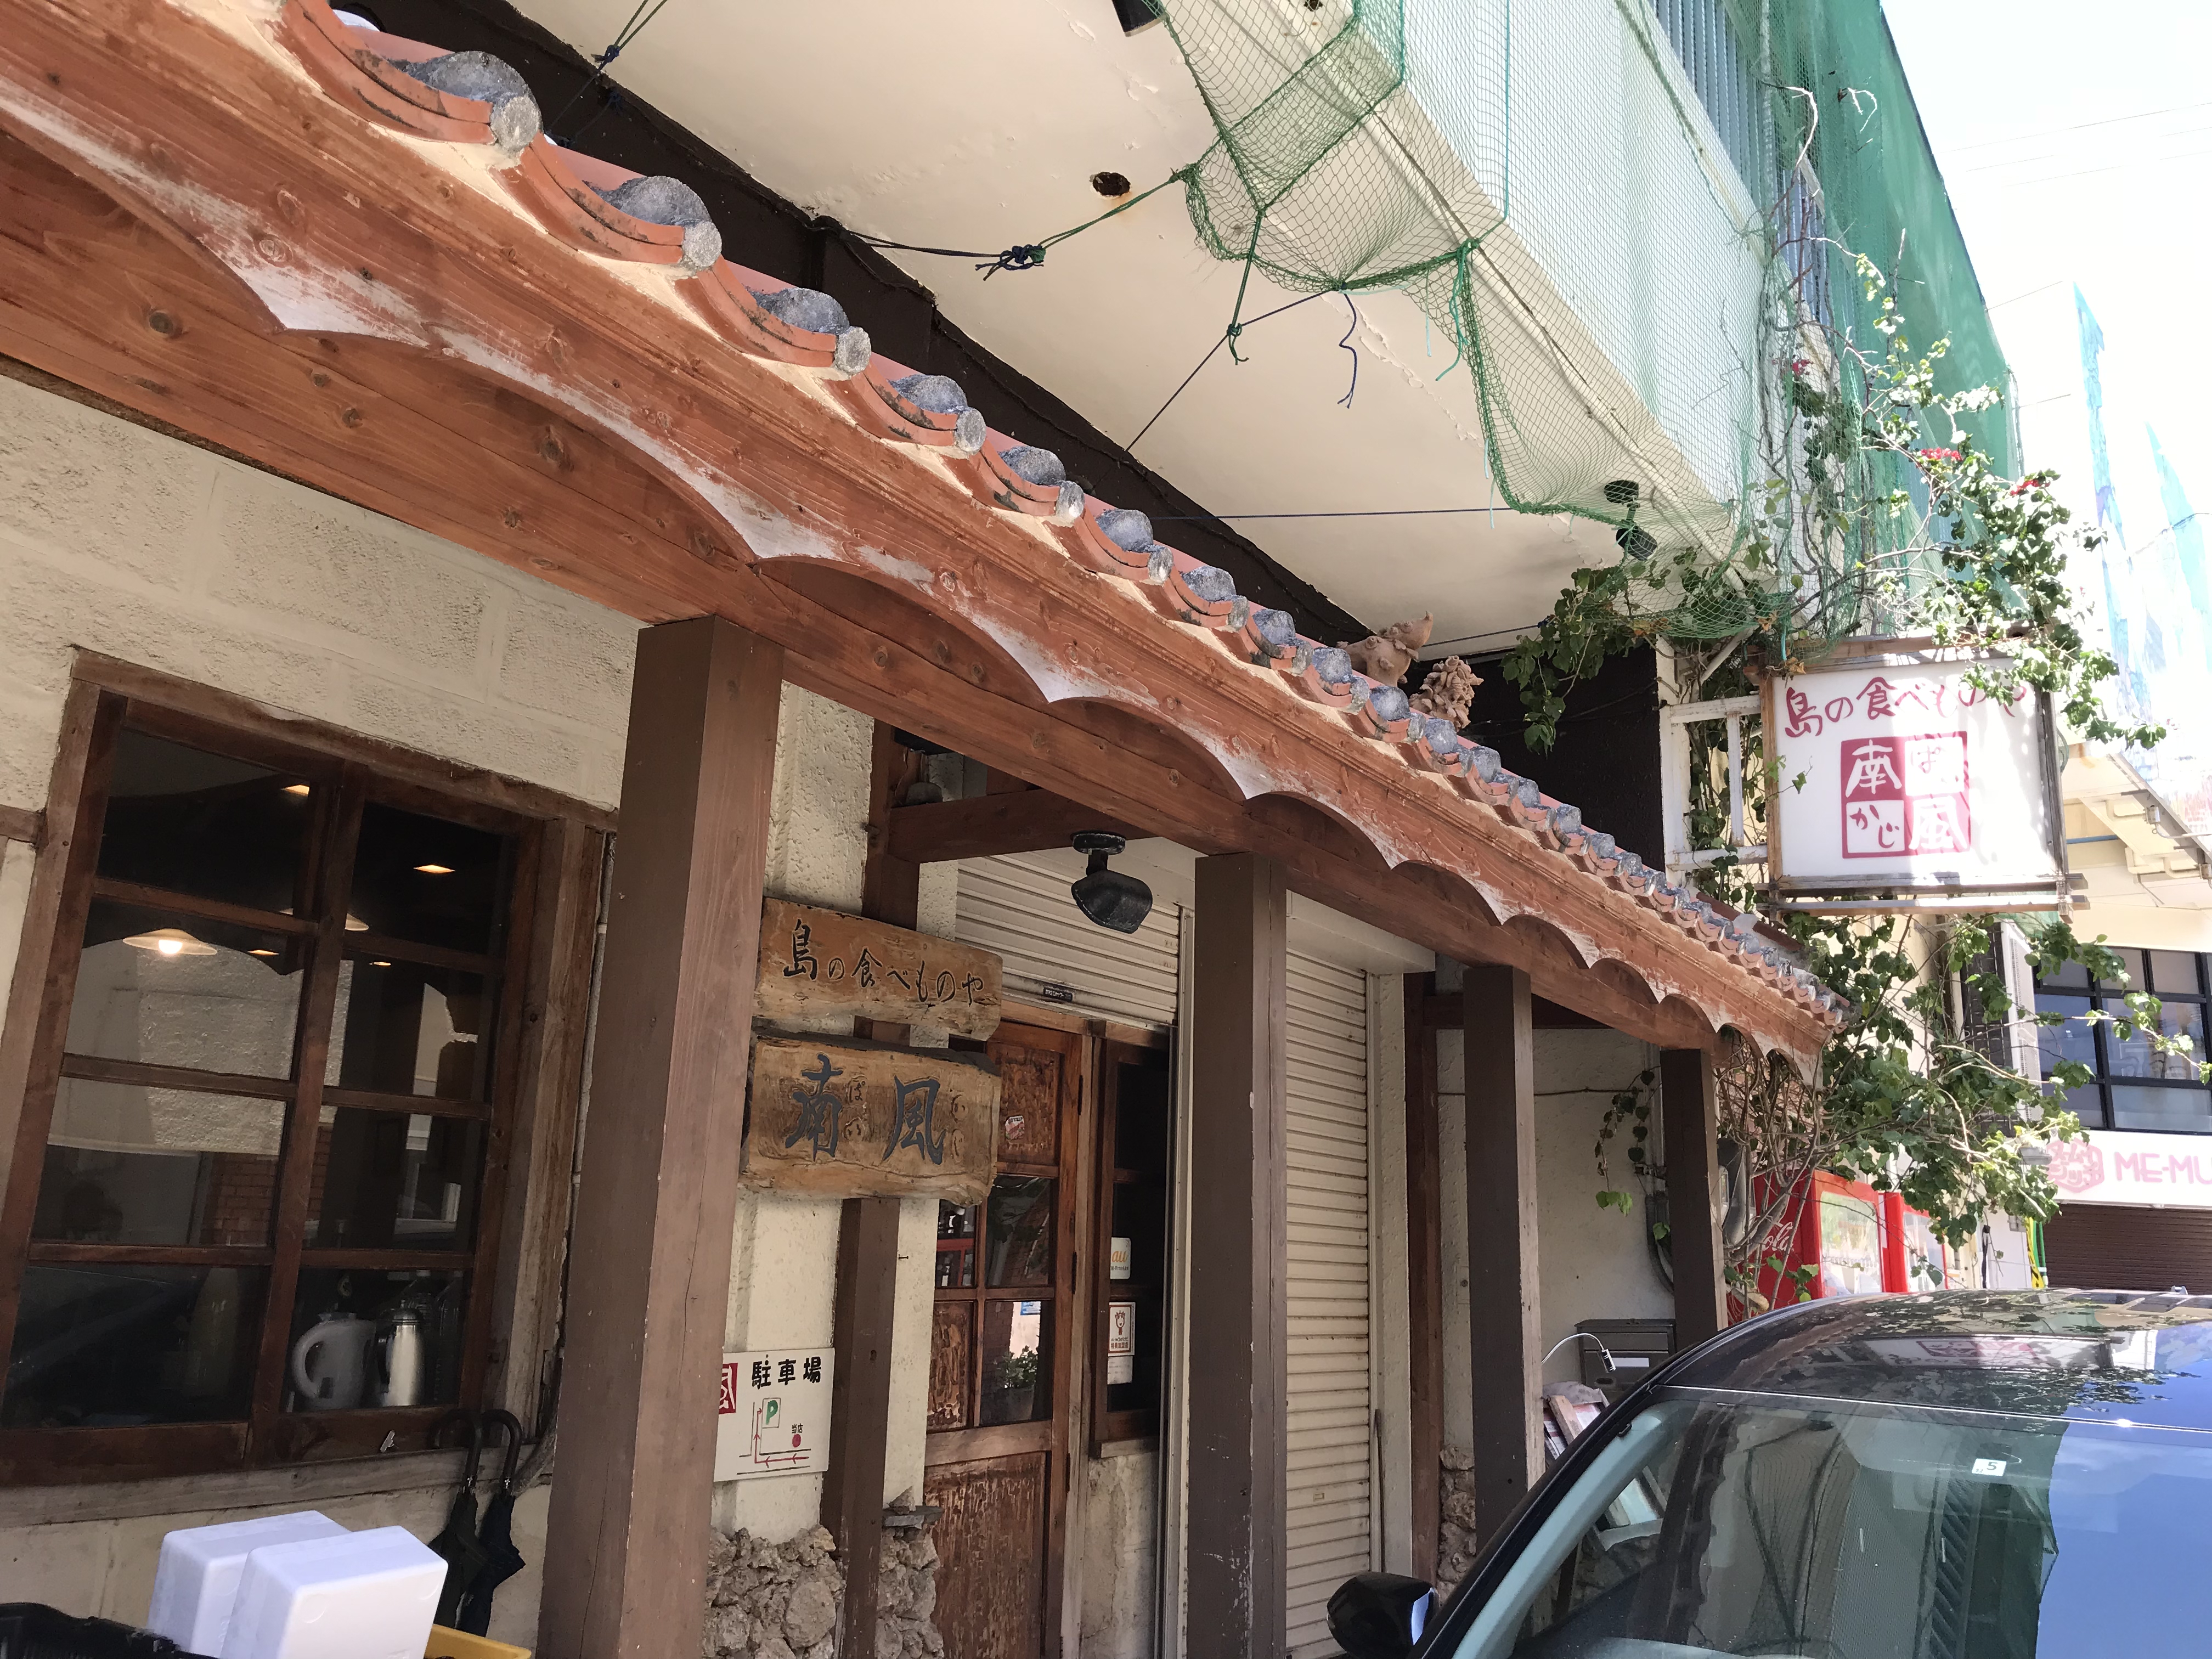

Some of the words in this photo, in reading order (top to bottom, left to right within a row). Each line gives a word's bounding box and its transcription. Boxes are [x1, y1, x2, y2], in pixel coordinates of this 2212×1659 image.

[783, 918, 984, 1006] 島の食べものや
[1111, 1250, 1129, 1262] au
[751, 1353, 822, 1390] 駐車場
[765, 1400, 778, 1425] P
[791, 1423, 804, 1434] 当店
[1986, 1461, 1998, 1471] 5
